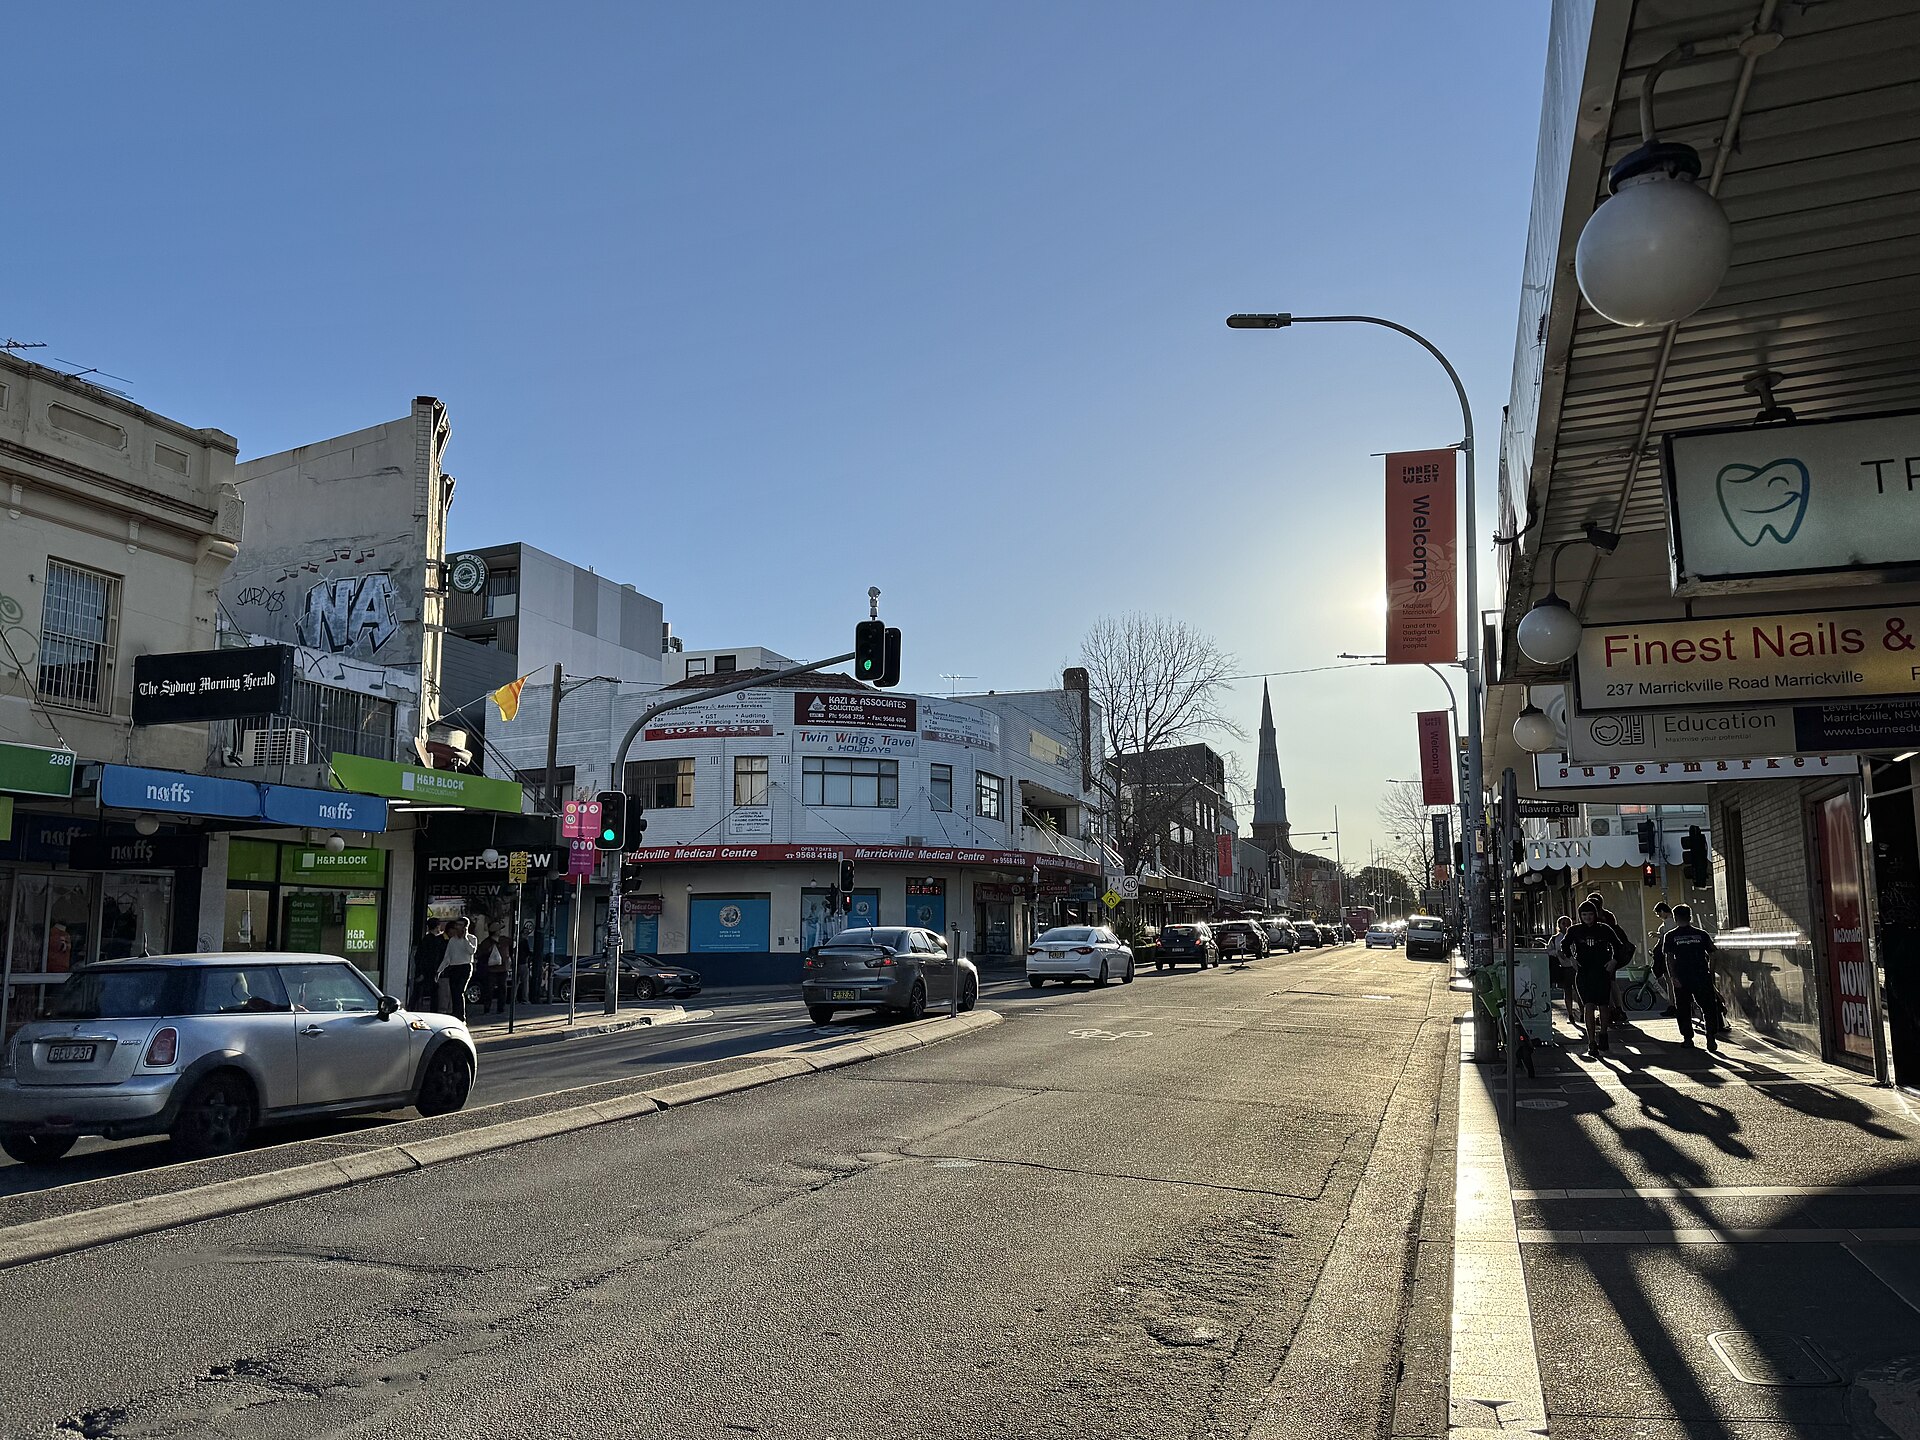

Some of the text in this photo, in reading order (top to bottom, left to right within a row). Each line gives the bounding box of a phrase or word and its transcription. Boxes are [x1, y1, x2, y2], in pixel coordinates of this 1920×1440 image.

[1402, 473, 1439, 484] WEST
[1412, 494, 1430, 593] Welcome
[1604, 617, 1915, 668] Finest Nails &
[139, 671, 276, 698] The Sydney Morning Herald
[1606, 670, 1864, 697] 237 Marrickville Road Marrickville
[828, 696, 907, 709] KAZI & ASSOCIATES
[828, 704, 863, 712] SOLICITORS
[1664, 712, 1777, 733] Education
[1823, 711, 1892, 724] Marrickville,
[664, 726, 709, 735] 8021
[938, 732, 967, 742] 8021
[799, 731, 915, 747] Twin Wings Travel
[837, 744, 891, 753] HOLIDAYS
[1430, 731, 1440, 775] Welcome
[49, 754, 71, 766] 288
[1559, 755, 1829, 780] supermarket
[417, 773, 464, 791] H&R BLOCK
[1519, 804, 1575, 813] Illawarra Rd
[630, 848, 758, 860] rickville Medical Centre
[795, 851, 816, 859] 9568
[854, 848, 986, 861] Marrickville Medical Centre
[1529, 840, 1591, 860] TRYN
[316, 856, 367, 865] H&R BLOCK
[428, 853, 552, 871] FROFF&BEW
[1036, 856, 1064, 867] Marrickville
[510, 867, 527, 875] 423
[1125, 880, 1136, 889] 40
[347, 929, 365, 939] H&R
[346, 939, 374, 949] BLOCK
[1838, 961, 1867, 997] NOW
[1842, 1001, 1871, 1037] OPEN
